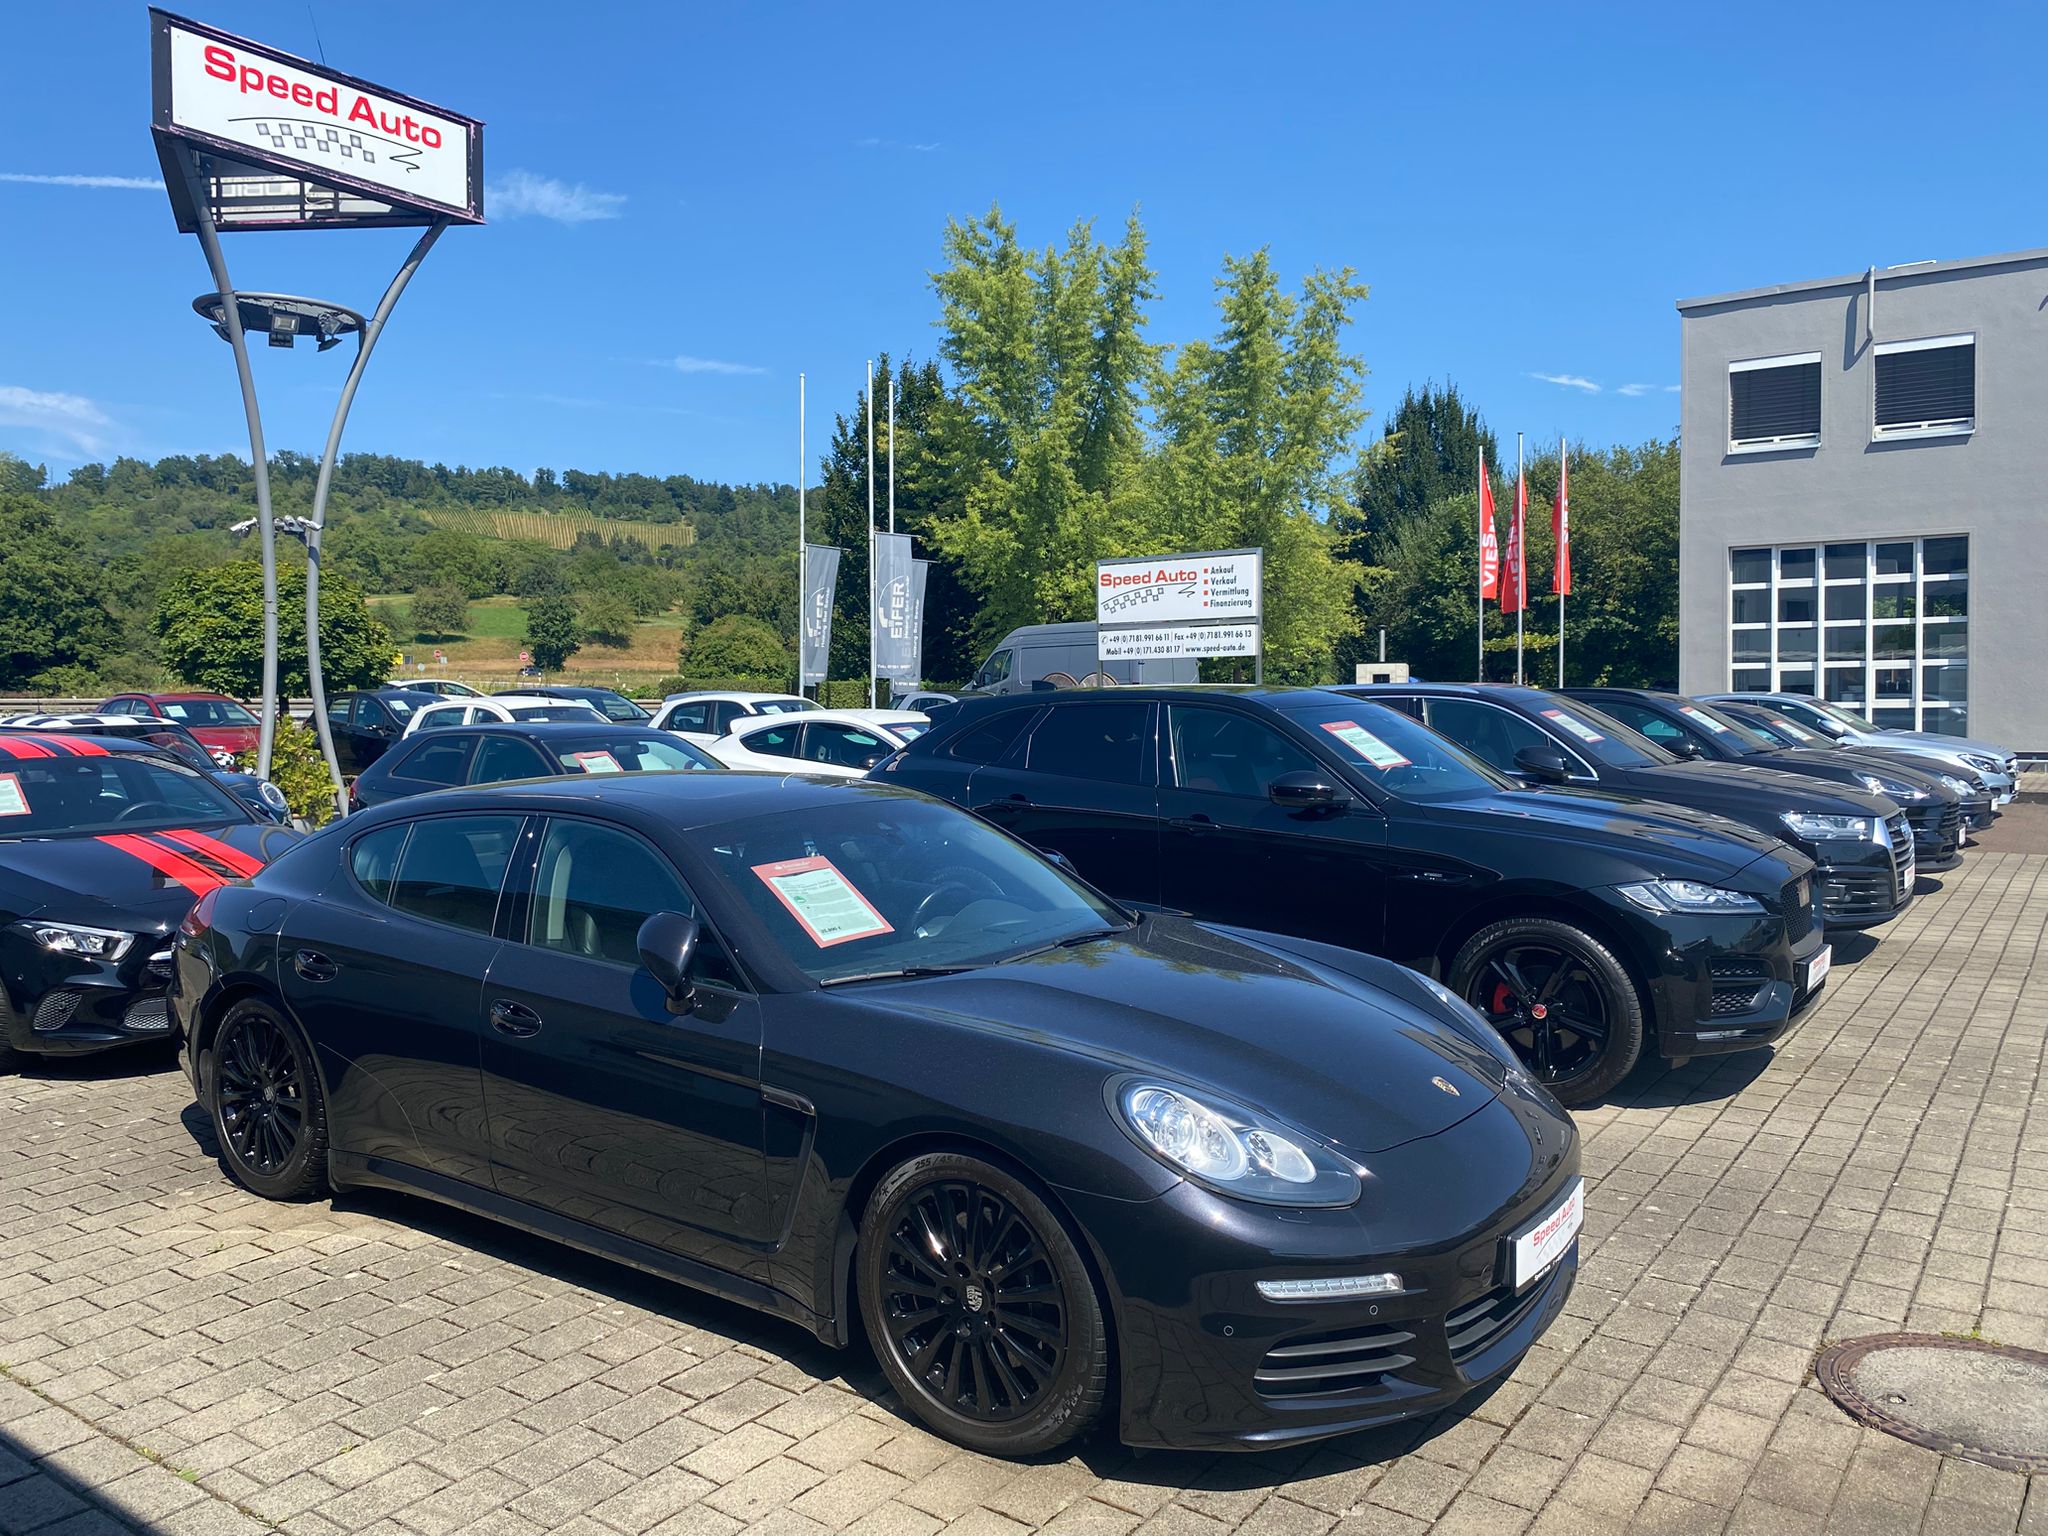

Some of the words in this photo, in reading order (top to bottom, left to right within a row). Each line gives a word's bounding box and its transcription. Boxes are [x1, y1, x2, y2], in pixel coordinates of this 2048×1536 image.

[204, 45, 338, 115] Speed
[348, 96, 442, 149] Auto
[1210, 564, 1234, 574] Ankauf
[1101, 571, 1151, 588] Speed
[1155, 570, 1197, 583] Auto
[1211, 575, 1237, 585] Verkauf
[1211, 586, 1249, 597] Vermittlung
[1210, 598, 1252, 608] Finanzierung
[1174, 632, 1184, 640] Fax
[1245, 630, 1252, 638] 13
[1185, 642, 1246, 654] www.speed-auto.de
[1533, 1215, 1560, 1246] Speed
[1561, 1196, 1576, 1218] Auto
